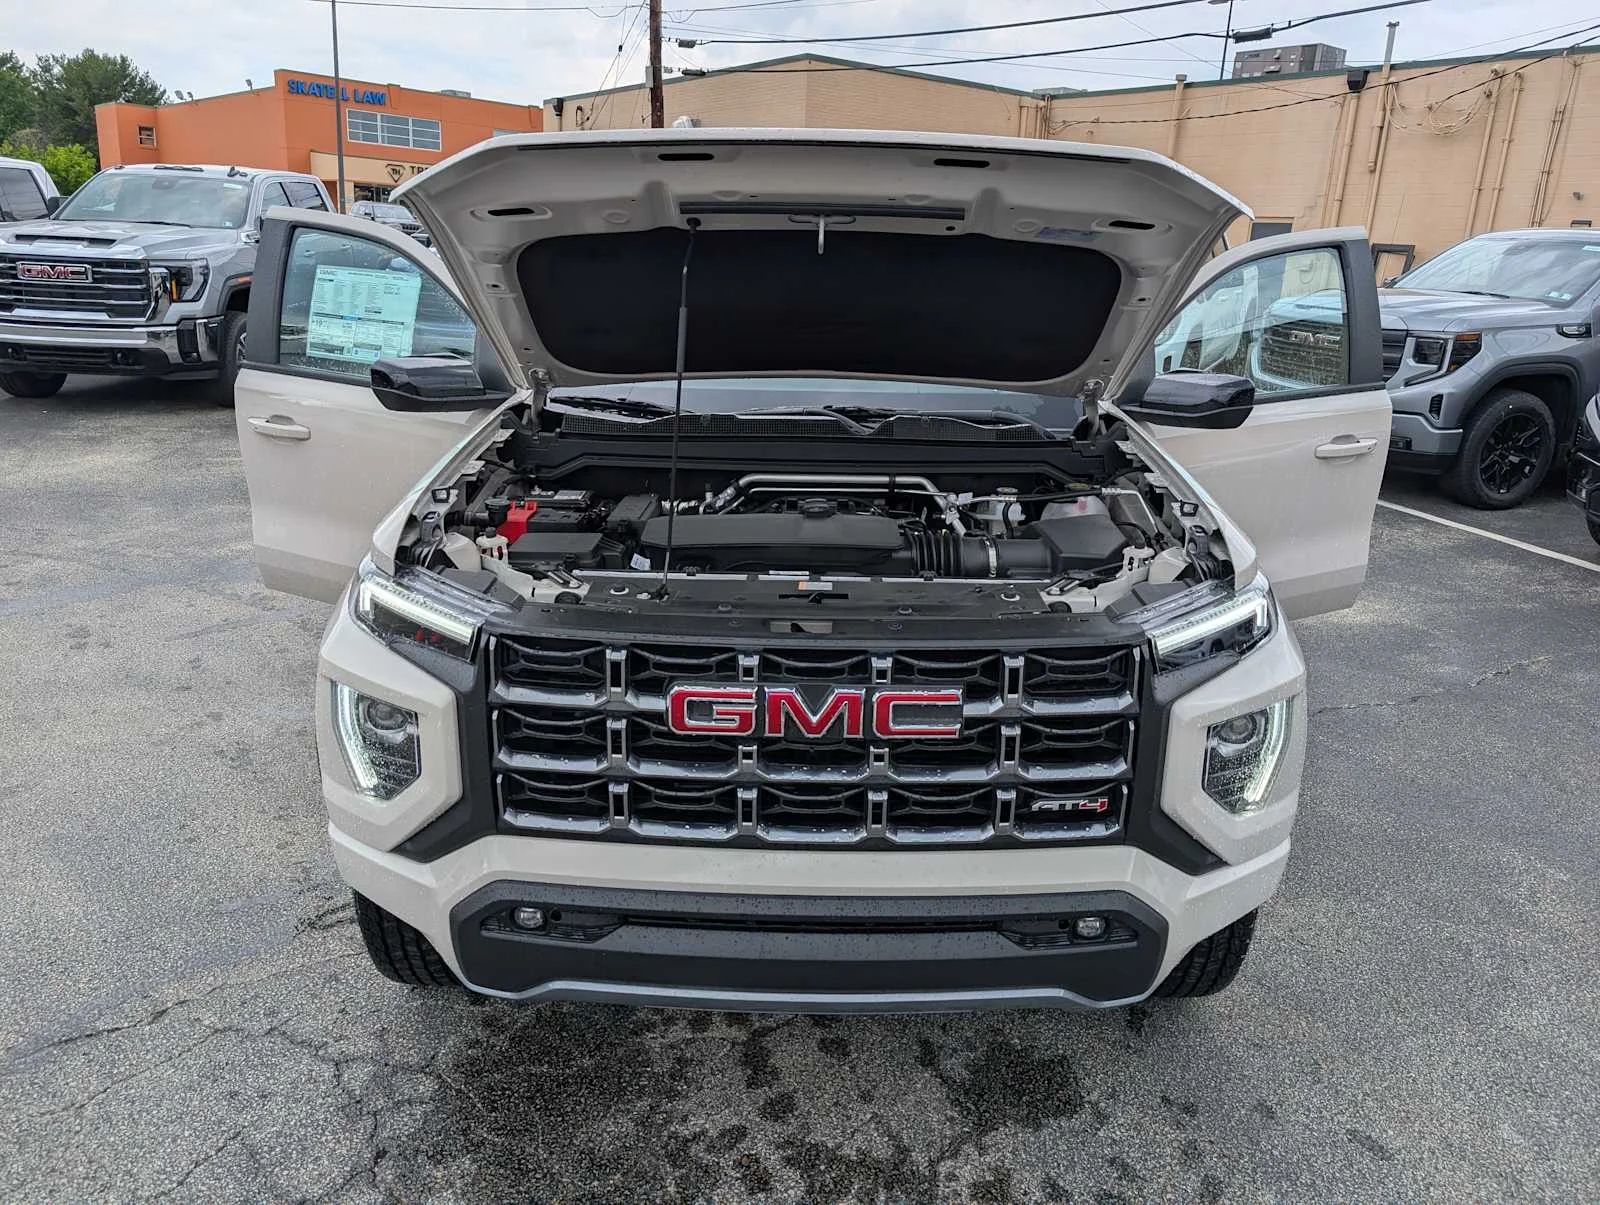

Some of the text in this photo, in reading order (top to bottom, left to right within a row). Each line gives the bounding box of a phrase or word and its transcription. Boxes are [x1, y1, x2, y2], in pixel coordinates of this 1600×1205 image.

[287, 79, 386, 105] SKATEL LAW
[21, 264, 87, 280] GMC
[667, 685, 963, 738] GMC
[1031, 798, 1109, 813] AT4
